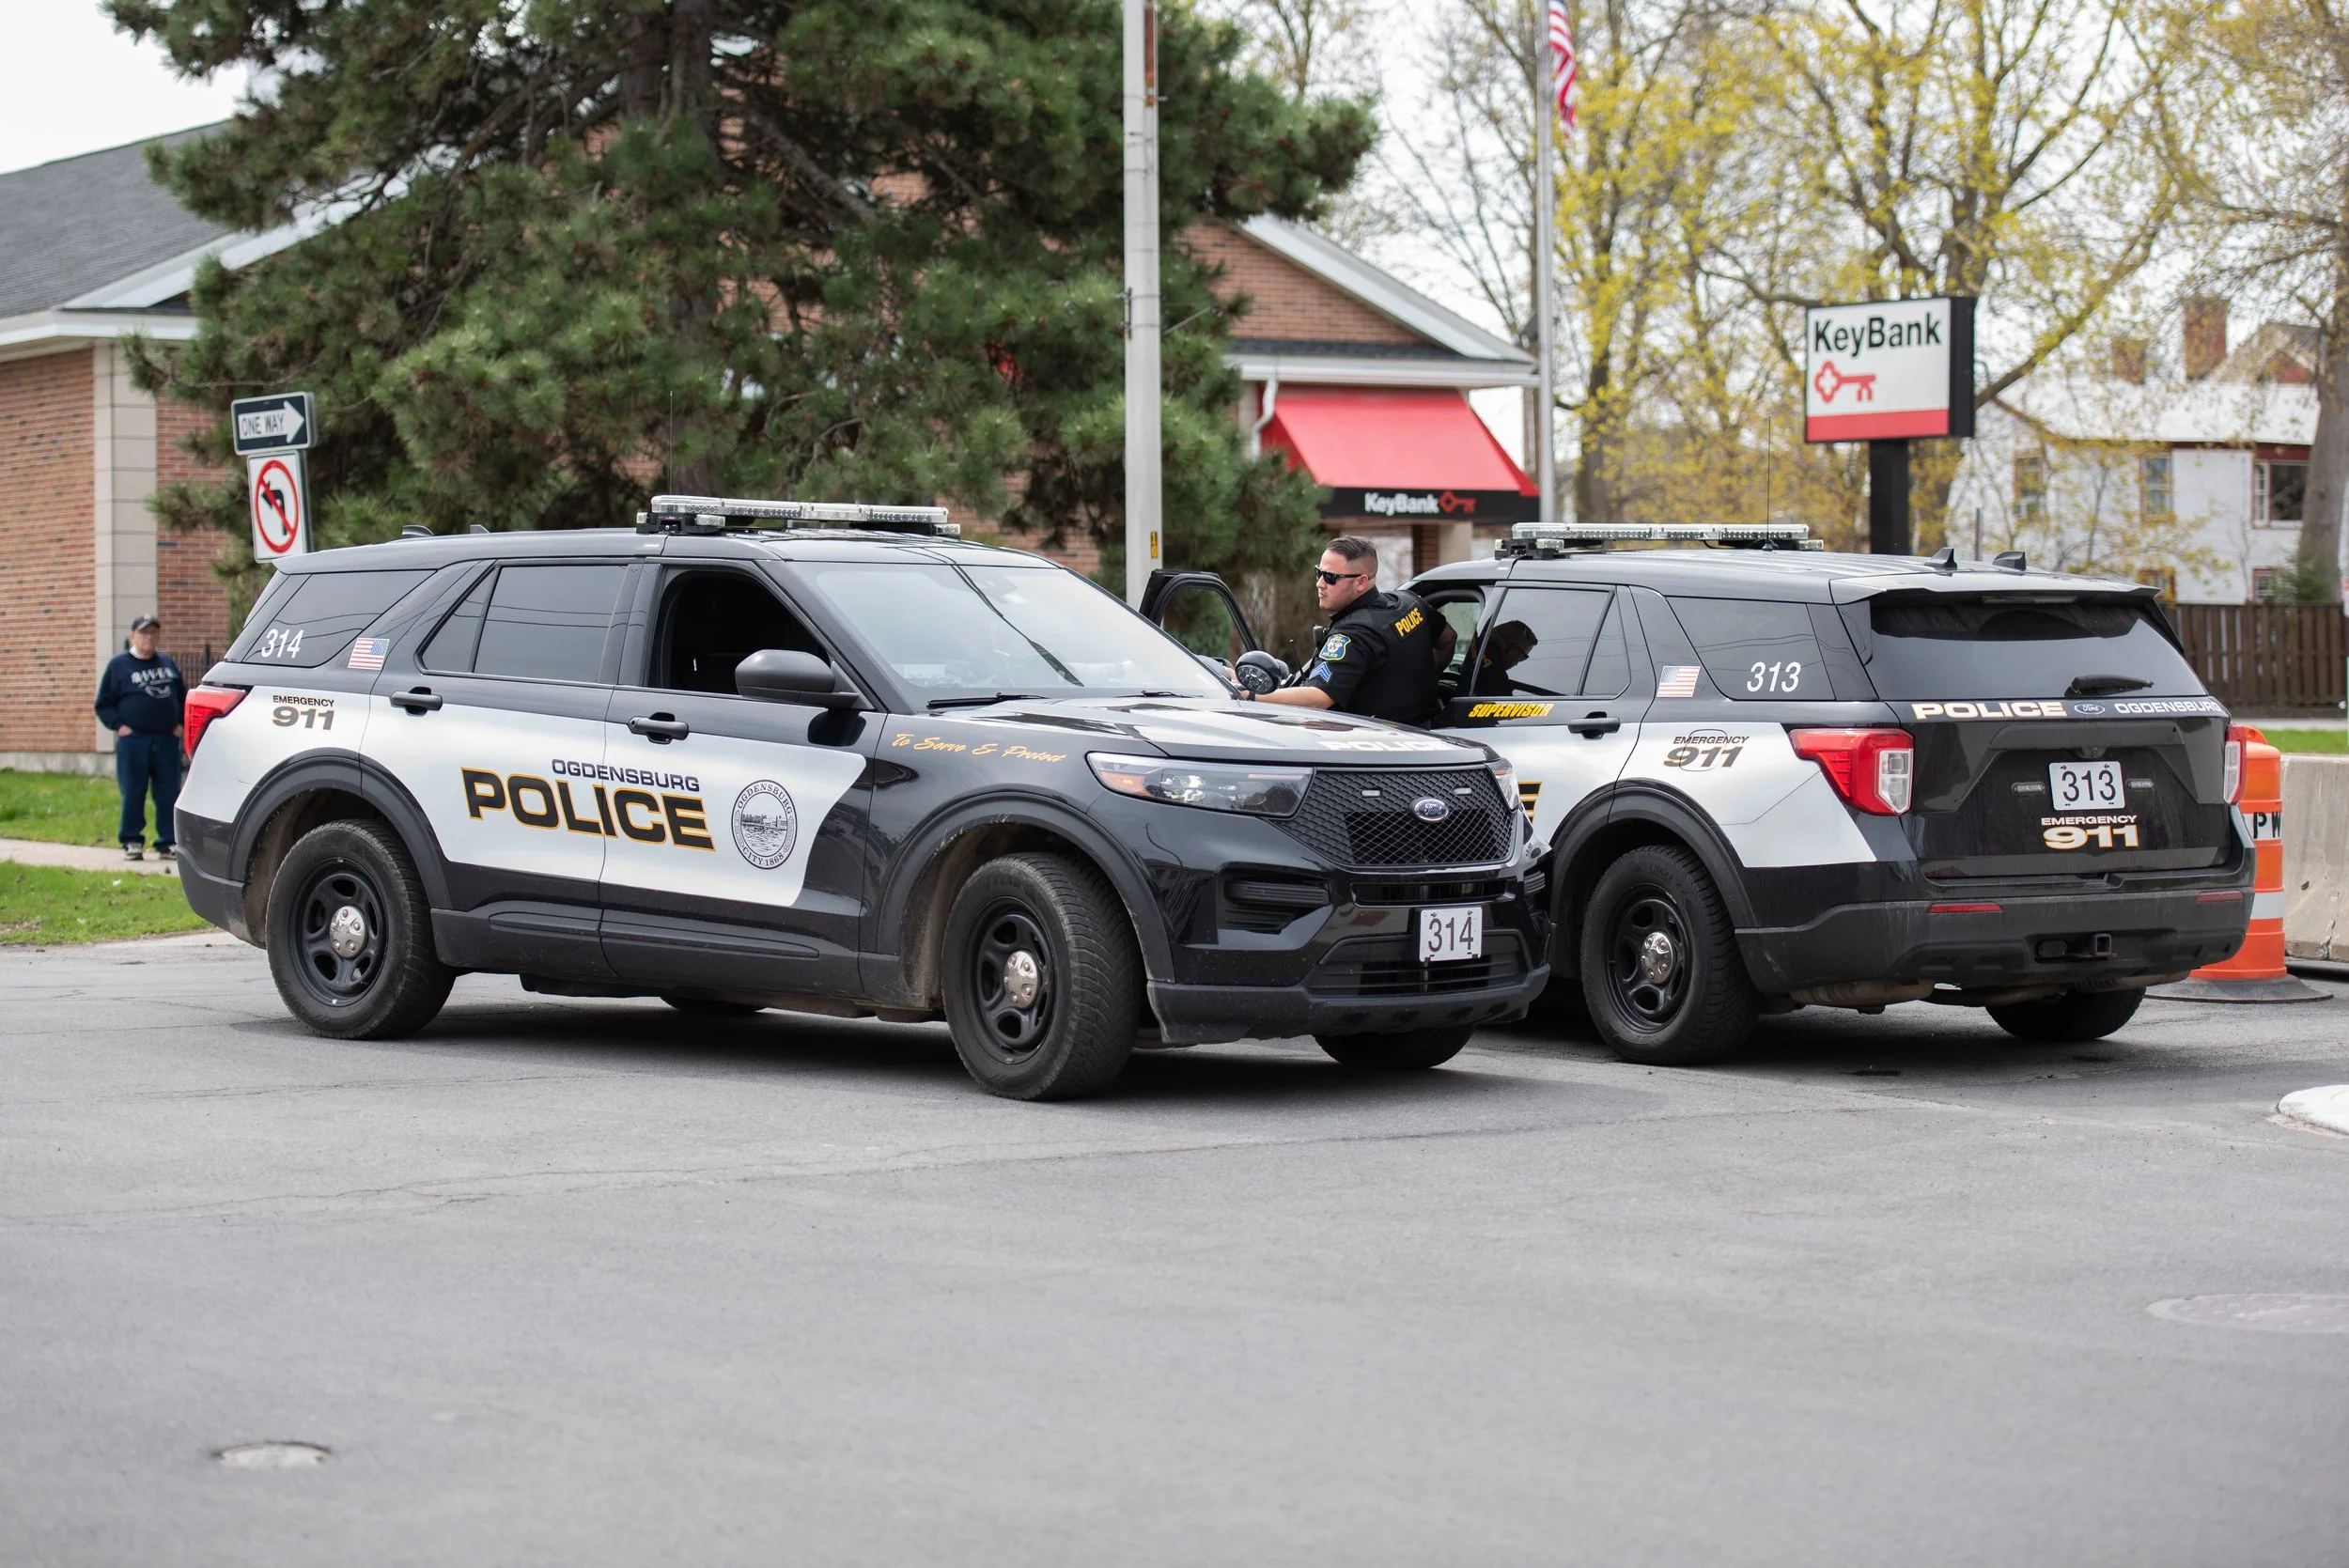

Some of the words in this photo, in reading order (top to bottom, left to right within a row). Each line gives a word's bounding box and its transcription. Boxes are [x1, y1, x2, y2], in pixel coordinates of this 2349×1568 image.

[1815, 312, 1941, 357] KeyBank
[241, 416, 261, 437] ONE
[264, 413, 285, 434] WAY
[1364, 492, 1439, 516] KeyBank
[1394, 607, 1424, 638] POLICE
[261, 629, 304, 659] 314
[1747, 661, 1802, 692] 313
[272, 694, 334, 707] EMERGENCY
[1468, 703, 1555, 718] SUPERVISOR
[1911, 702, 2068, 720] POLICE
[2114, 700, 2222, 714] OGDENSBURG
[272, 706, 334, 730] 911
[892, 734, 914, 747] To
[913, 737, 967, 753] Serve
[972, 743, 998, 755] &
[1002, 745, 1067, 763] Protect
[1672, 736, 1750, 745] EMERGENCY
[1663, 746, 1744, 768] 911
[552, 759, 700, 792] OGDENSBURG
[2061, 769, 2116, 802] 313
[460, 767, 716, 852] POLICE
[737, 784, 793, 815] OGDENSBURG
[2041, 815, 2138, 826] EMERGENCY
[2242, 811, 2281, 839] PW
[2043, 825, 2139, 850] 911
[742, 846, 763, 865] CITY
[765, 852, 785, 866] 1868
[1427, 916, 1473, 952] 314
